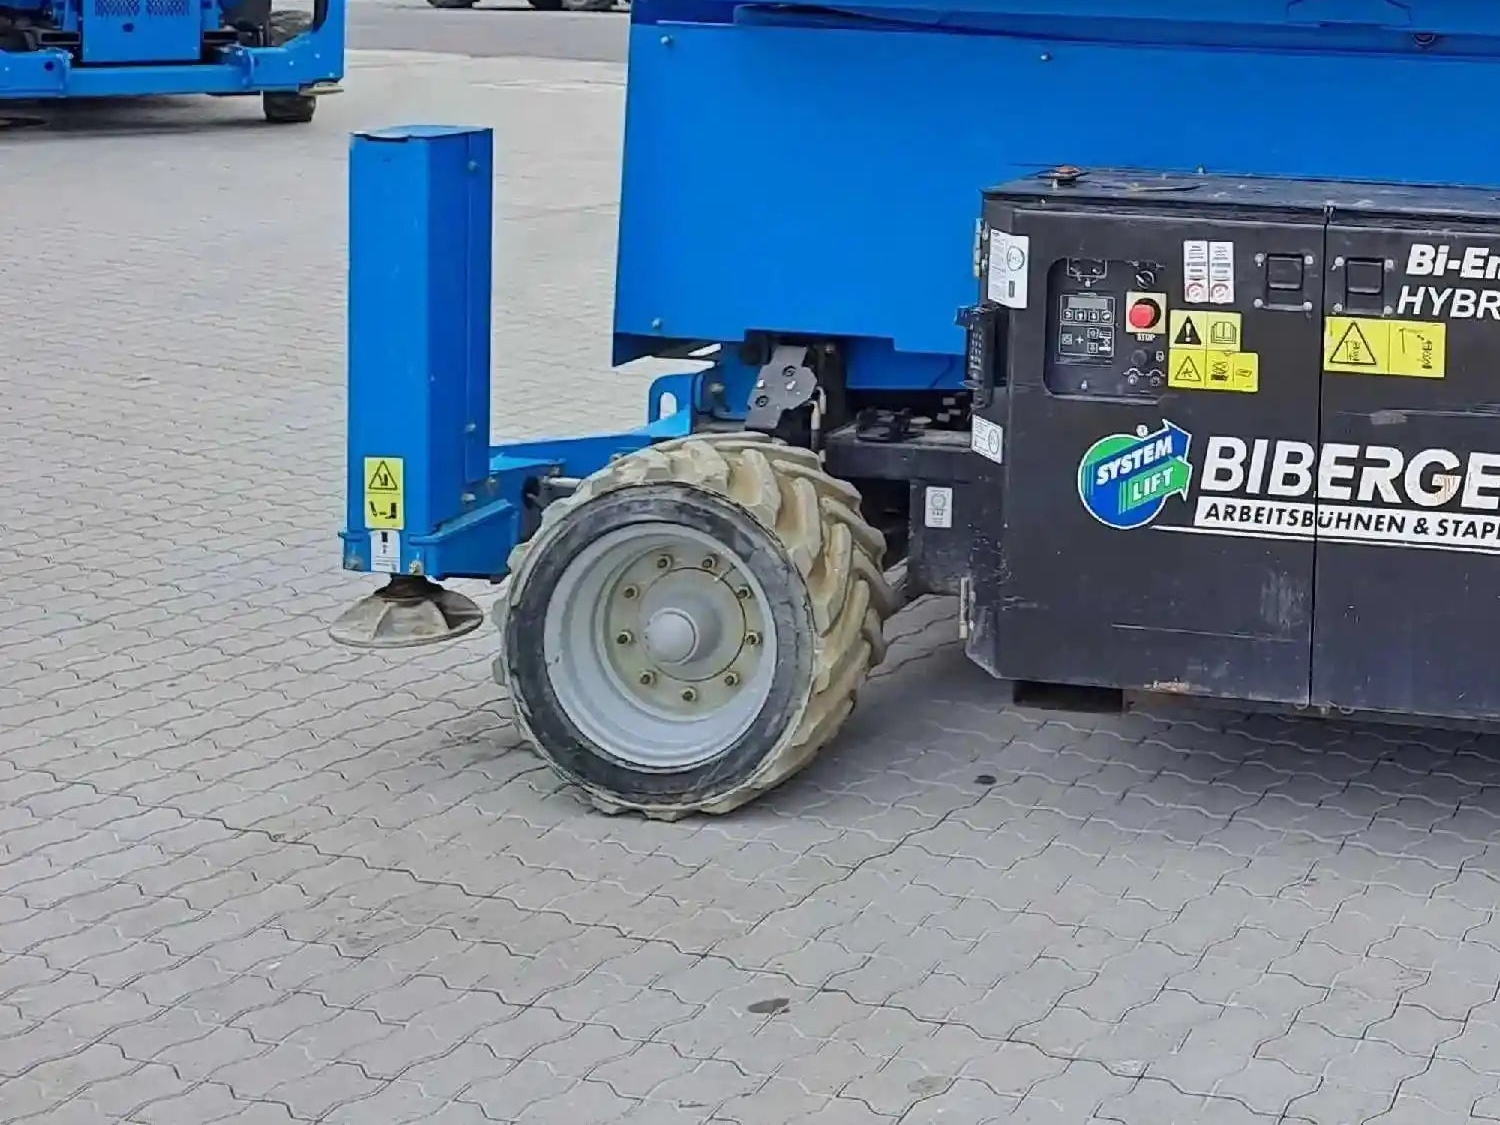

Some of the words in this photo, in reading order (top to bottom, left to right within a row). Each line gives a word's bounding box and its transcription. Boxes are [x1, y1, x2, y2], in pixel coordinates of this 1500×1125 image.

[1096, 435, 1172, 485] SYSTEM
[1133, 467, 1173, 501] LIFT
[1204, 501, 1406, 533] ARBEITSBÜHNEN
[1412, 516, 1429, 536] &
